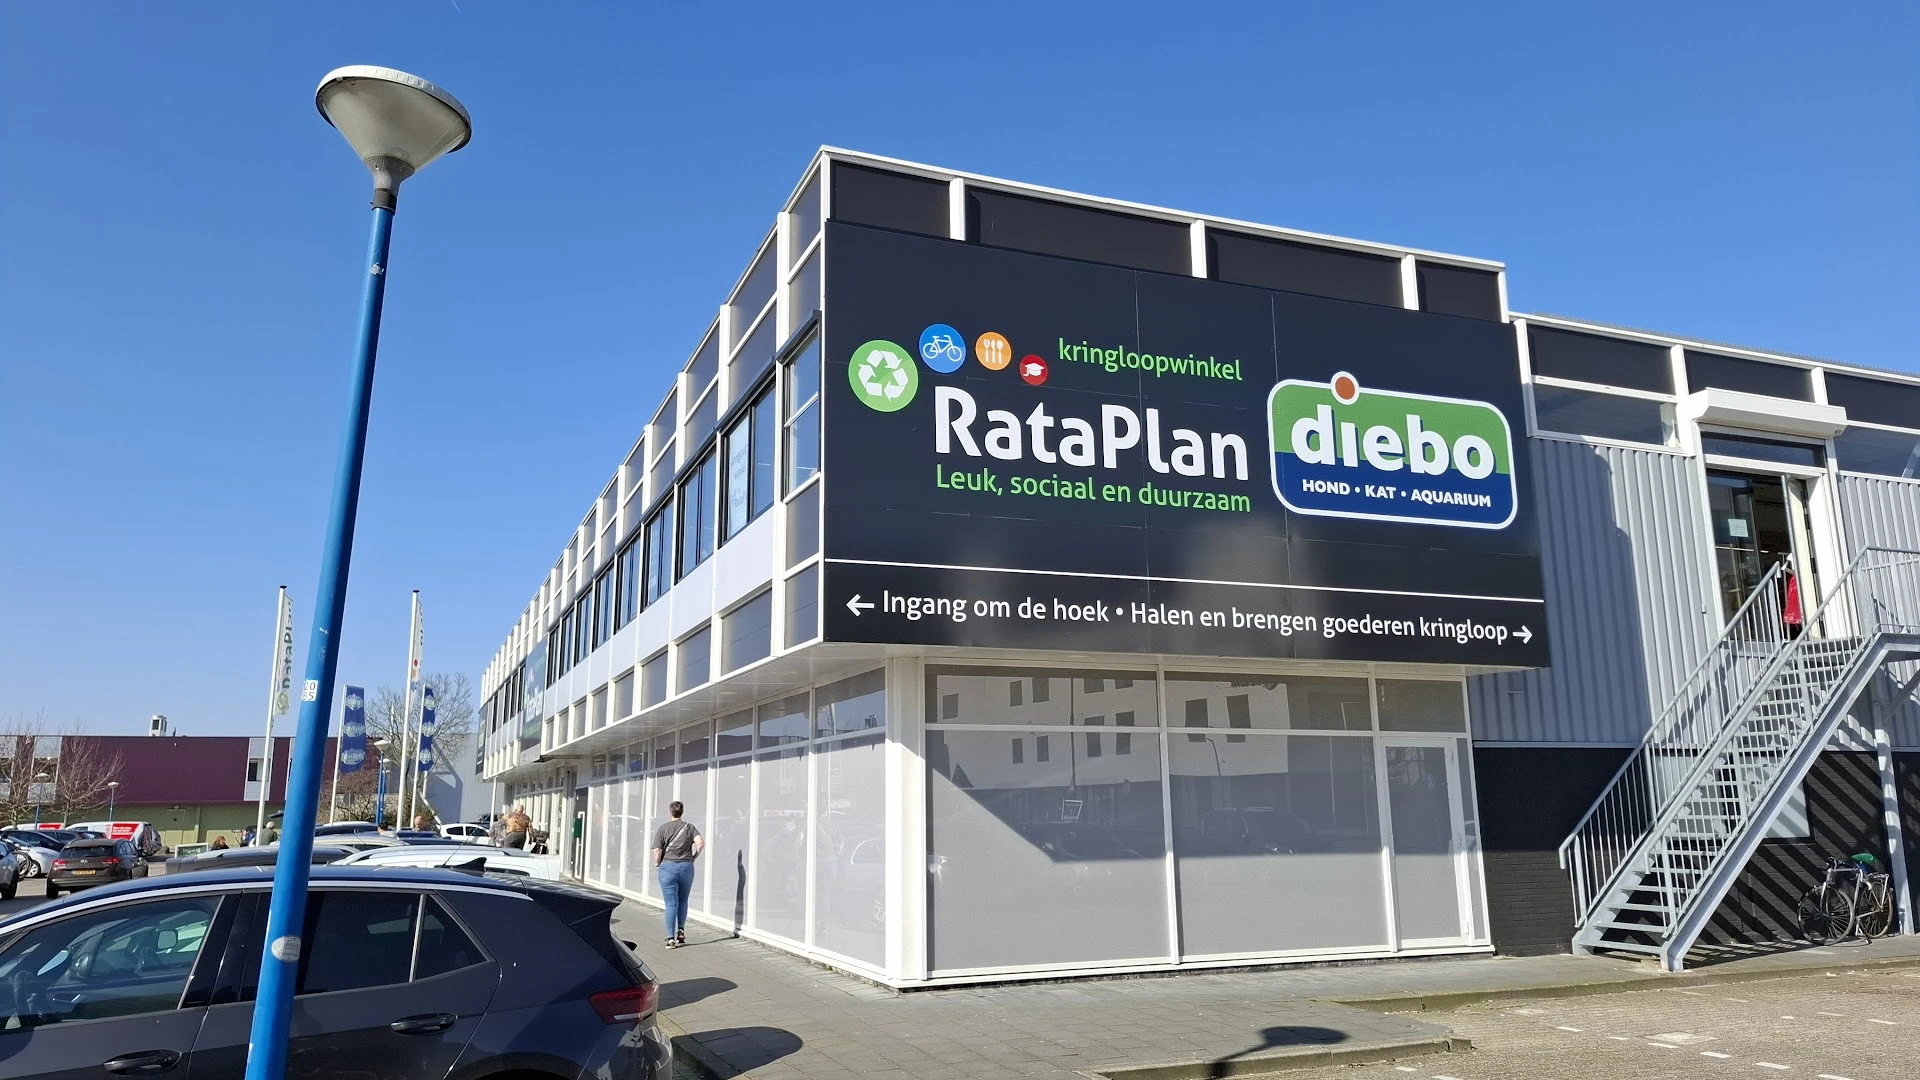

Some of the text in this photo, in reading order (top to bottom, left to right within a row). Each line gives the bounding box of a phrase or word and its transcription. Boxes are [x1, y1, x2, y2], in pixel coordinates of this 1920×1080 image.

[1059, 338, 1242, 381] kringloopwinkel
[934, 385, 1250, 481] RataPlan
[1290, 403, 1496, 480] diebo
[936, 463, 1251, 512] Leuk, sociaal en duurzaam
[1302, 478, 1492, 508] HOND KAT AQUARIUM
[883, 589, 1508, 646] Ingang om de hoek Halen en brengen goederen kringloop
